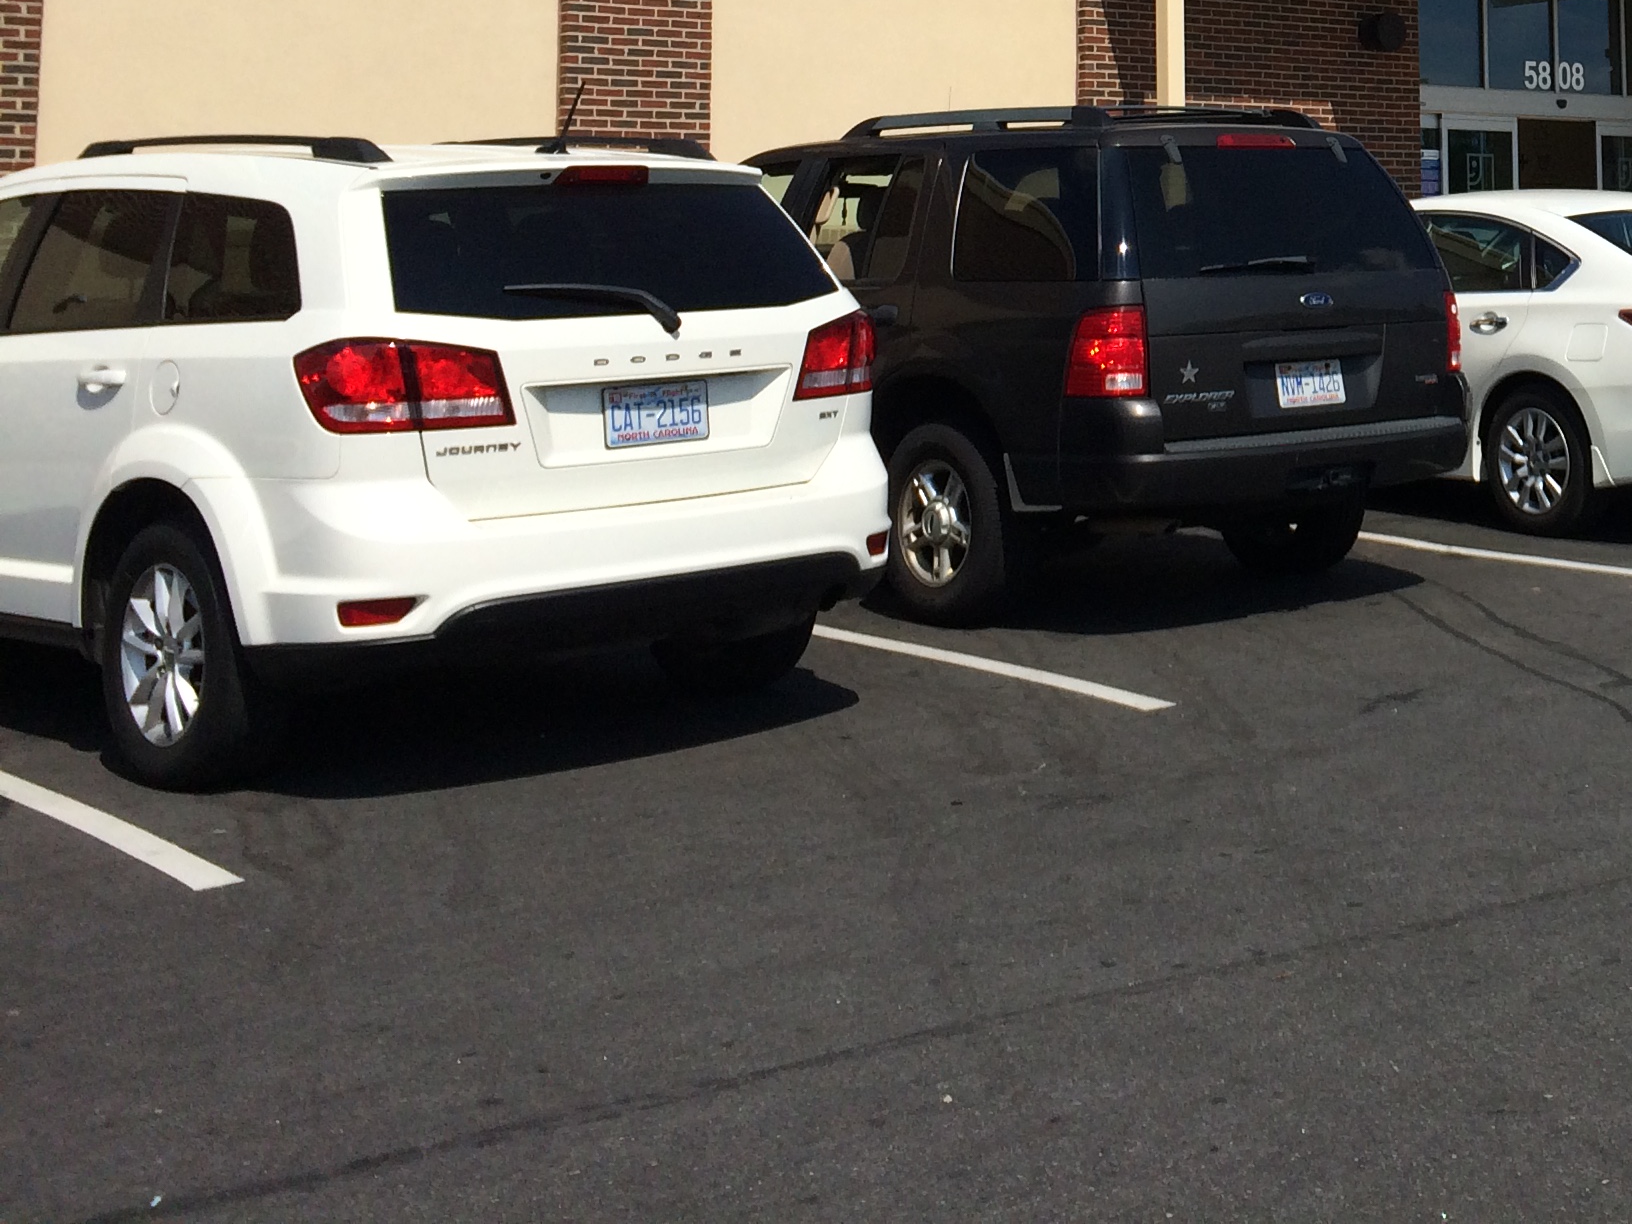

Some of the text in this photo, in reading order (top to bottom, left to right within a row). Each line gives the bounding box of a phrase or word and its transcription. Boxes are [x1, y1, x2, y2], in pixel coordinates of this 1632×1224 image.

[1524, 60, 1585, 92] 5808
[593, 349, 742, 365] DODGE
[1163, 390, 1235, 404] EXPLORER
[611, 396, 702, 432] CAT-2156
[617, 426, 699, 442] NORTH CAROLINA
[436, 441, 521, 457] JOURNEY
